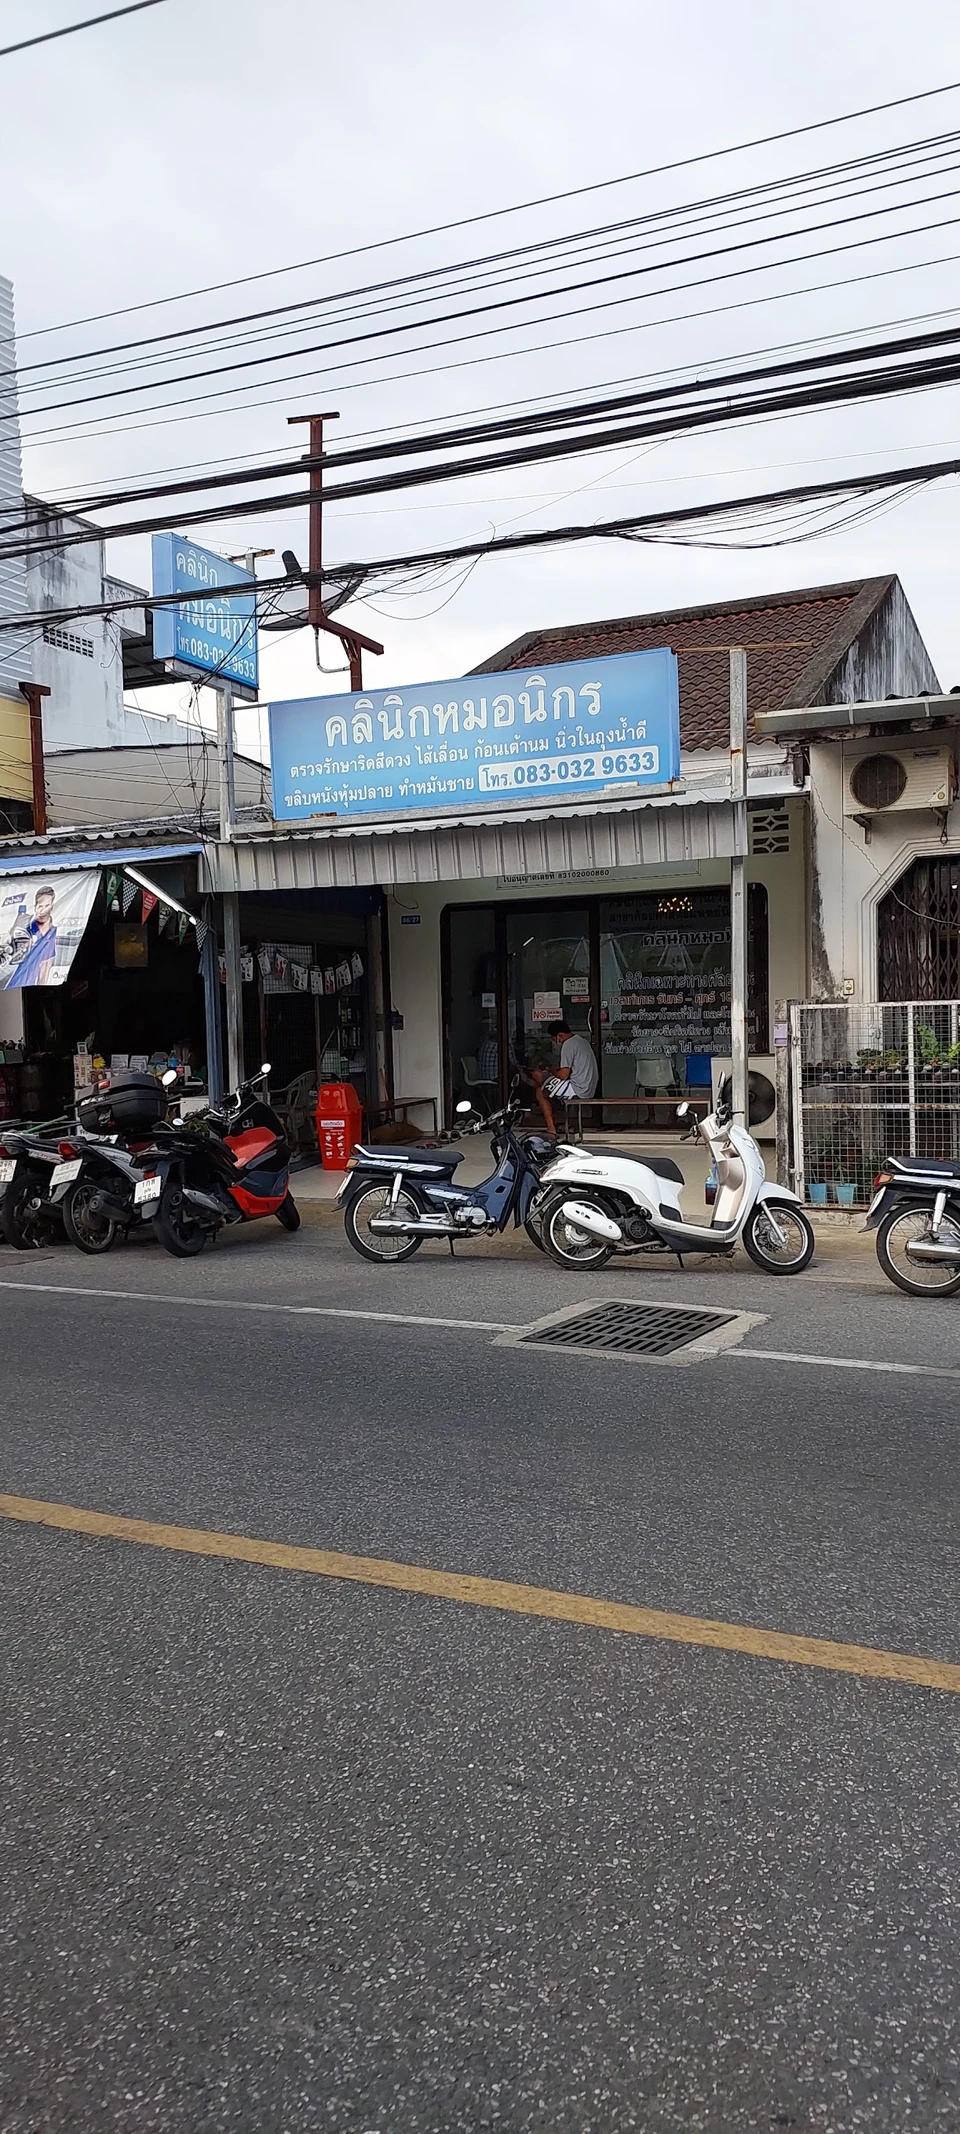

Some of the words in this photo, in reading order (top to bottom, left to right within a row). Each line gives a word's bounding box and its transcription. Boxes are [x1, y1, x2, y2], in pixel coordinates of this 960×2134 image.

[176, 549, 218, 588] คลินิก
[325, 674, 602, 747] คลินิกหมอนิกร
[290, 751, 411, 778] ตรวจรักษาริดสีดวง
[414, 741, 469, 766] ไส้เลื่อน
[474, 734, 549, 759] ก้อนเต้านม
[555, 717, 647, 751] นิ่วในถุงน้ำดี
[284, 783, 393, 809] ขลิบหนังหุ้มปลาย
[398, 773, 474, 797] ทำหมันชาย
[601, 751, 655, 776] 9633
